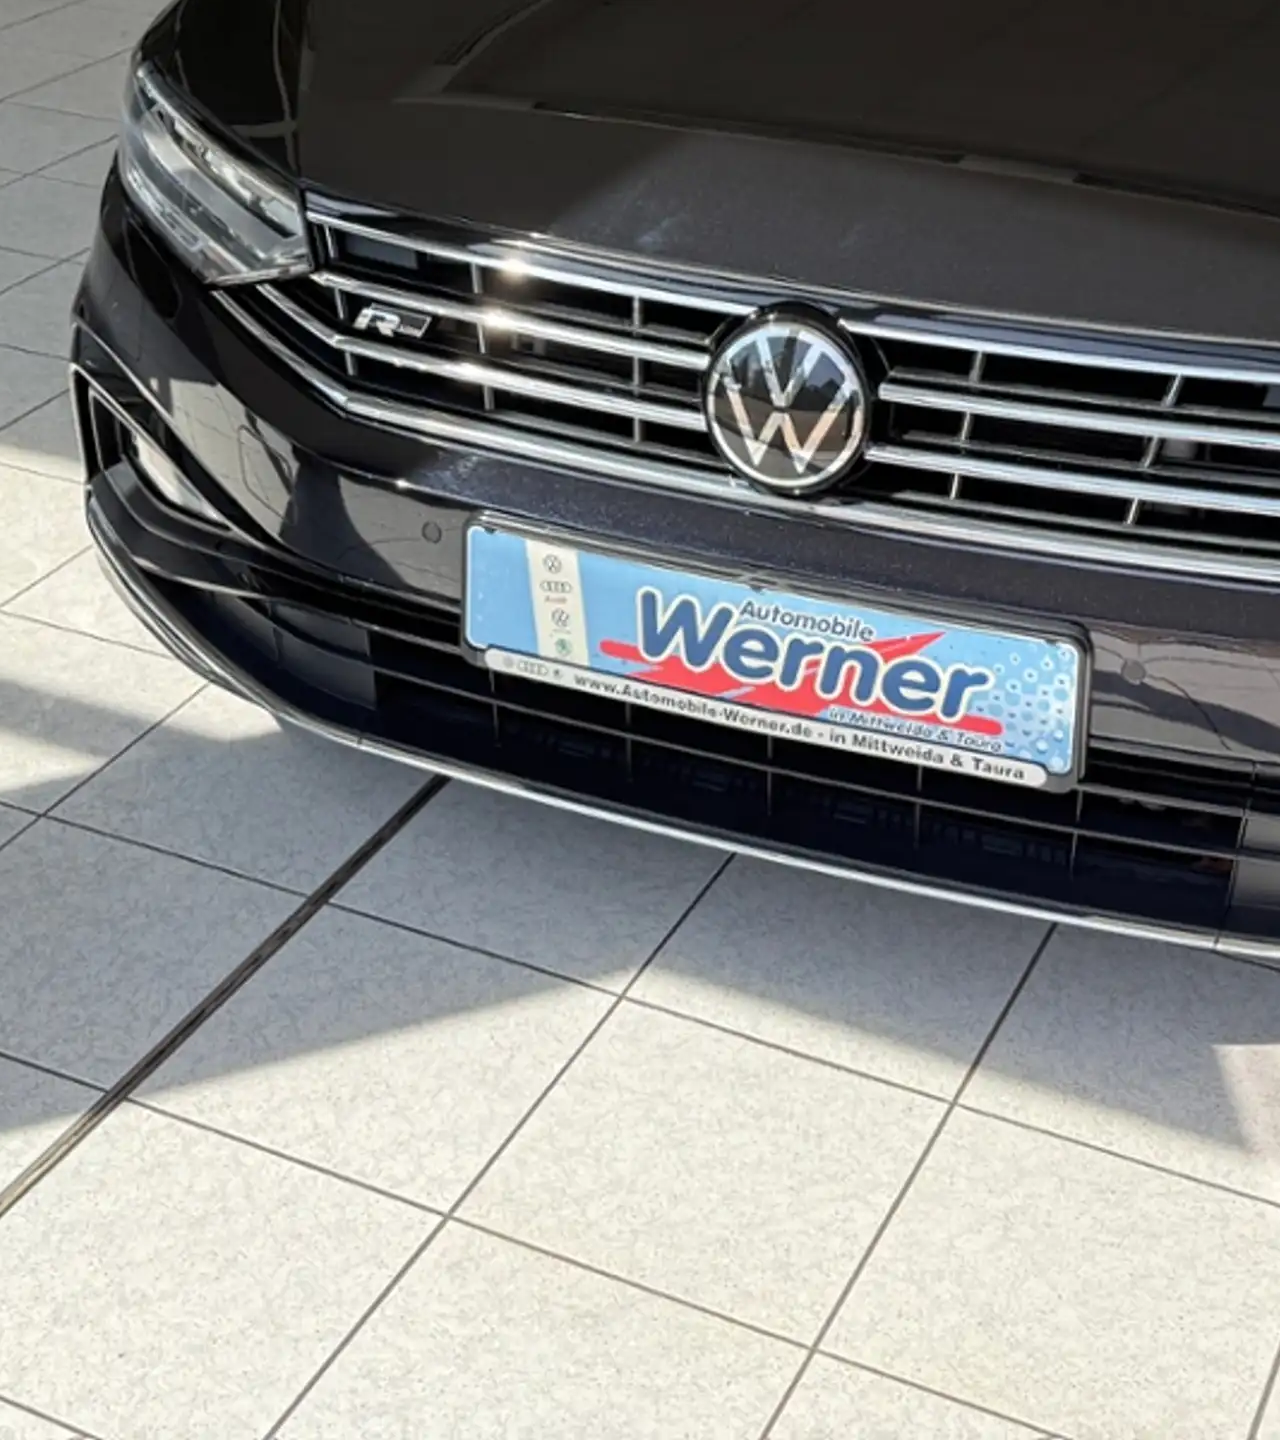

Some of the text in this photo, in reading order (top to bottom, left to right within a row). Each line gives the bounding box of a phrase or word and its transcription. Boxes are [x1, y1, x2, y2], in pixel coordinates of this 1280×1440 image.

[636, 586, 995, 723] Werner
[739, 600, 874, 643] Automobile
[574, 673, 812, 739] www.Automobile-Werner.de
[829, 728, 846, 745] in
[851, 732, 944, 765] Mittweida
[950, 753, 964, 768] &
[972, 756, 1025, 781] Taura
